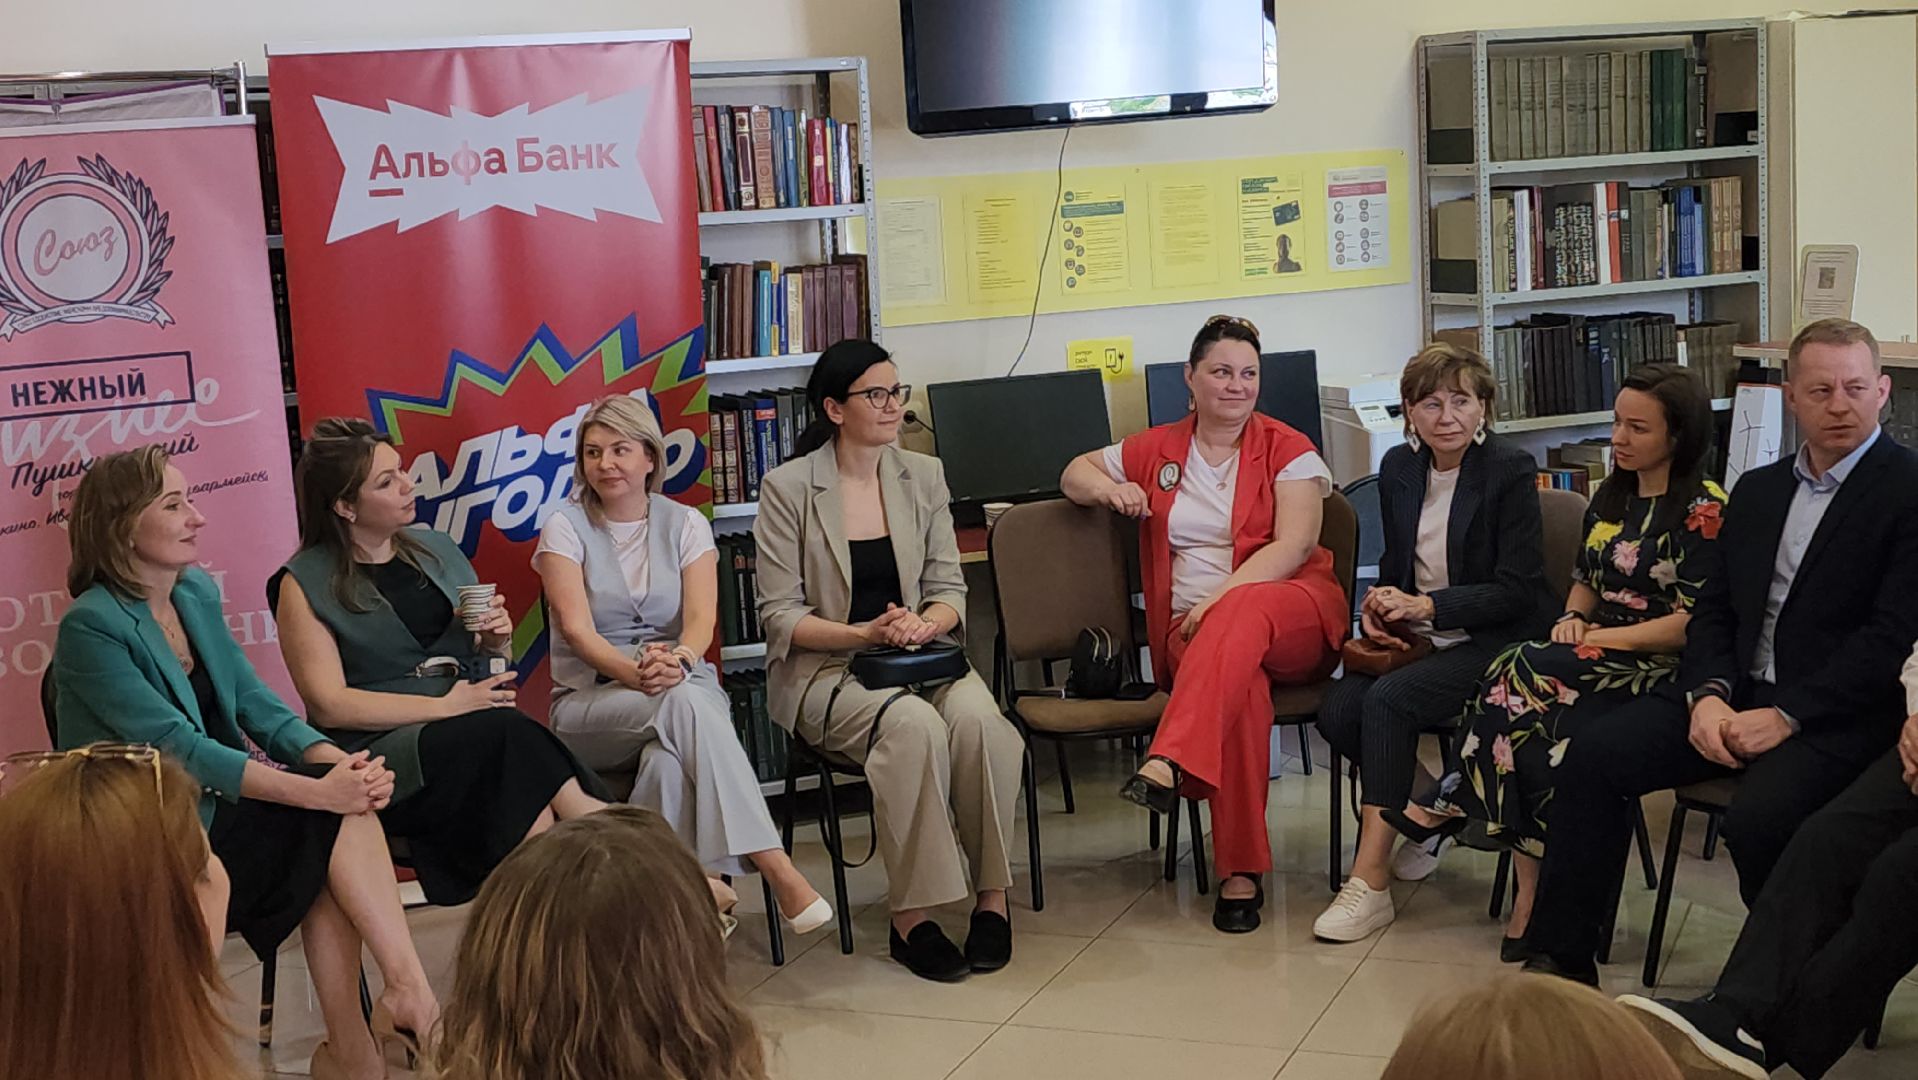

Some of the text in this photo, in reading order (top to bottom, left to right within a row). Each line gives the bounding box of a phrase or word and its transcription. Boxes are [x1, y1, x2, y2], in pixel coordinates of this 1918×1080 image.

[368, 137, 620, 187] Альфа Банк
[34, 225, 118, 277] Союз
[11, 368, 147, 407] НЕЖНЫЙ
[409, 387, 650, 500] АЛЬФ
